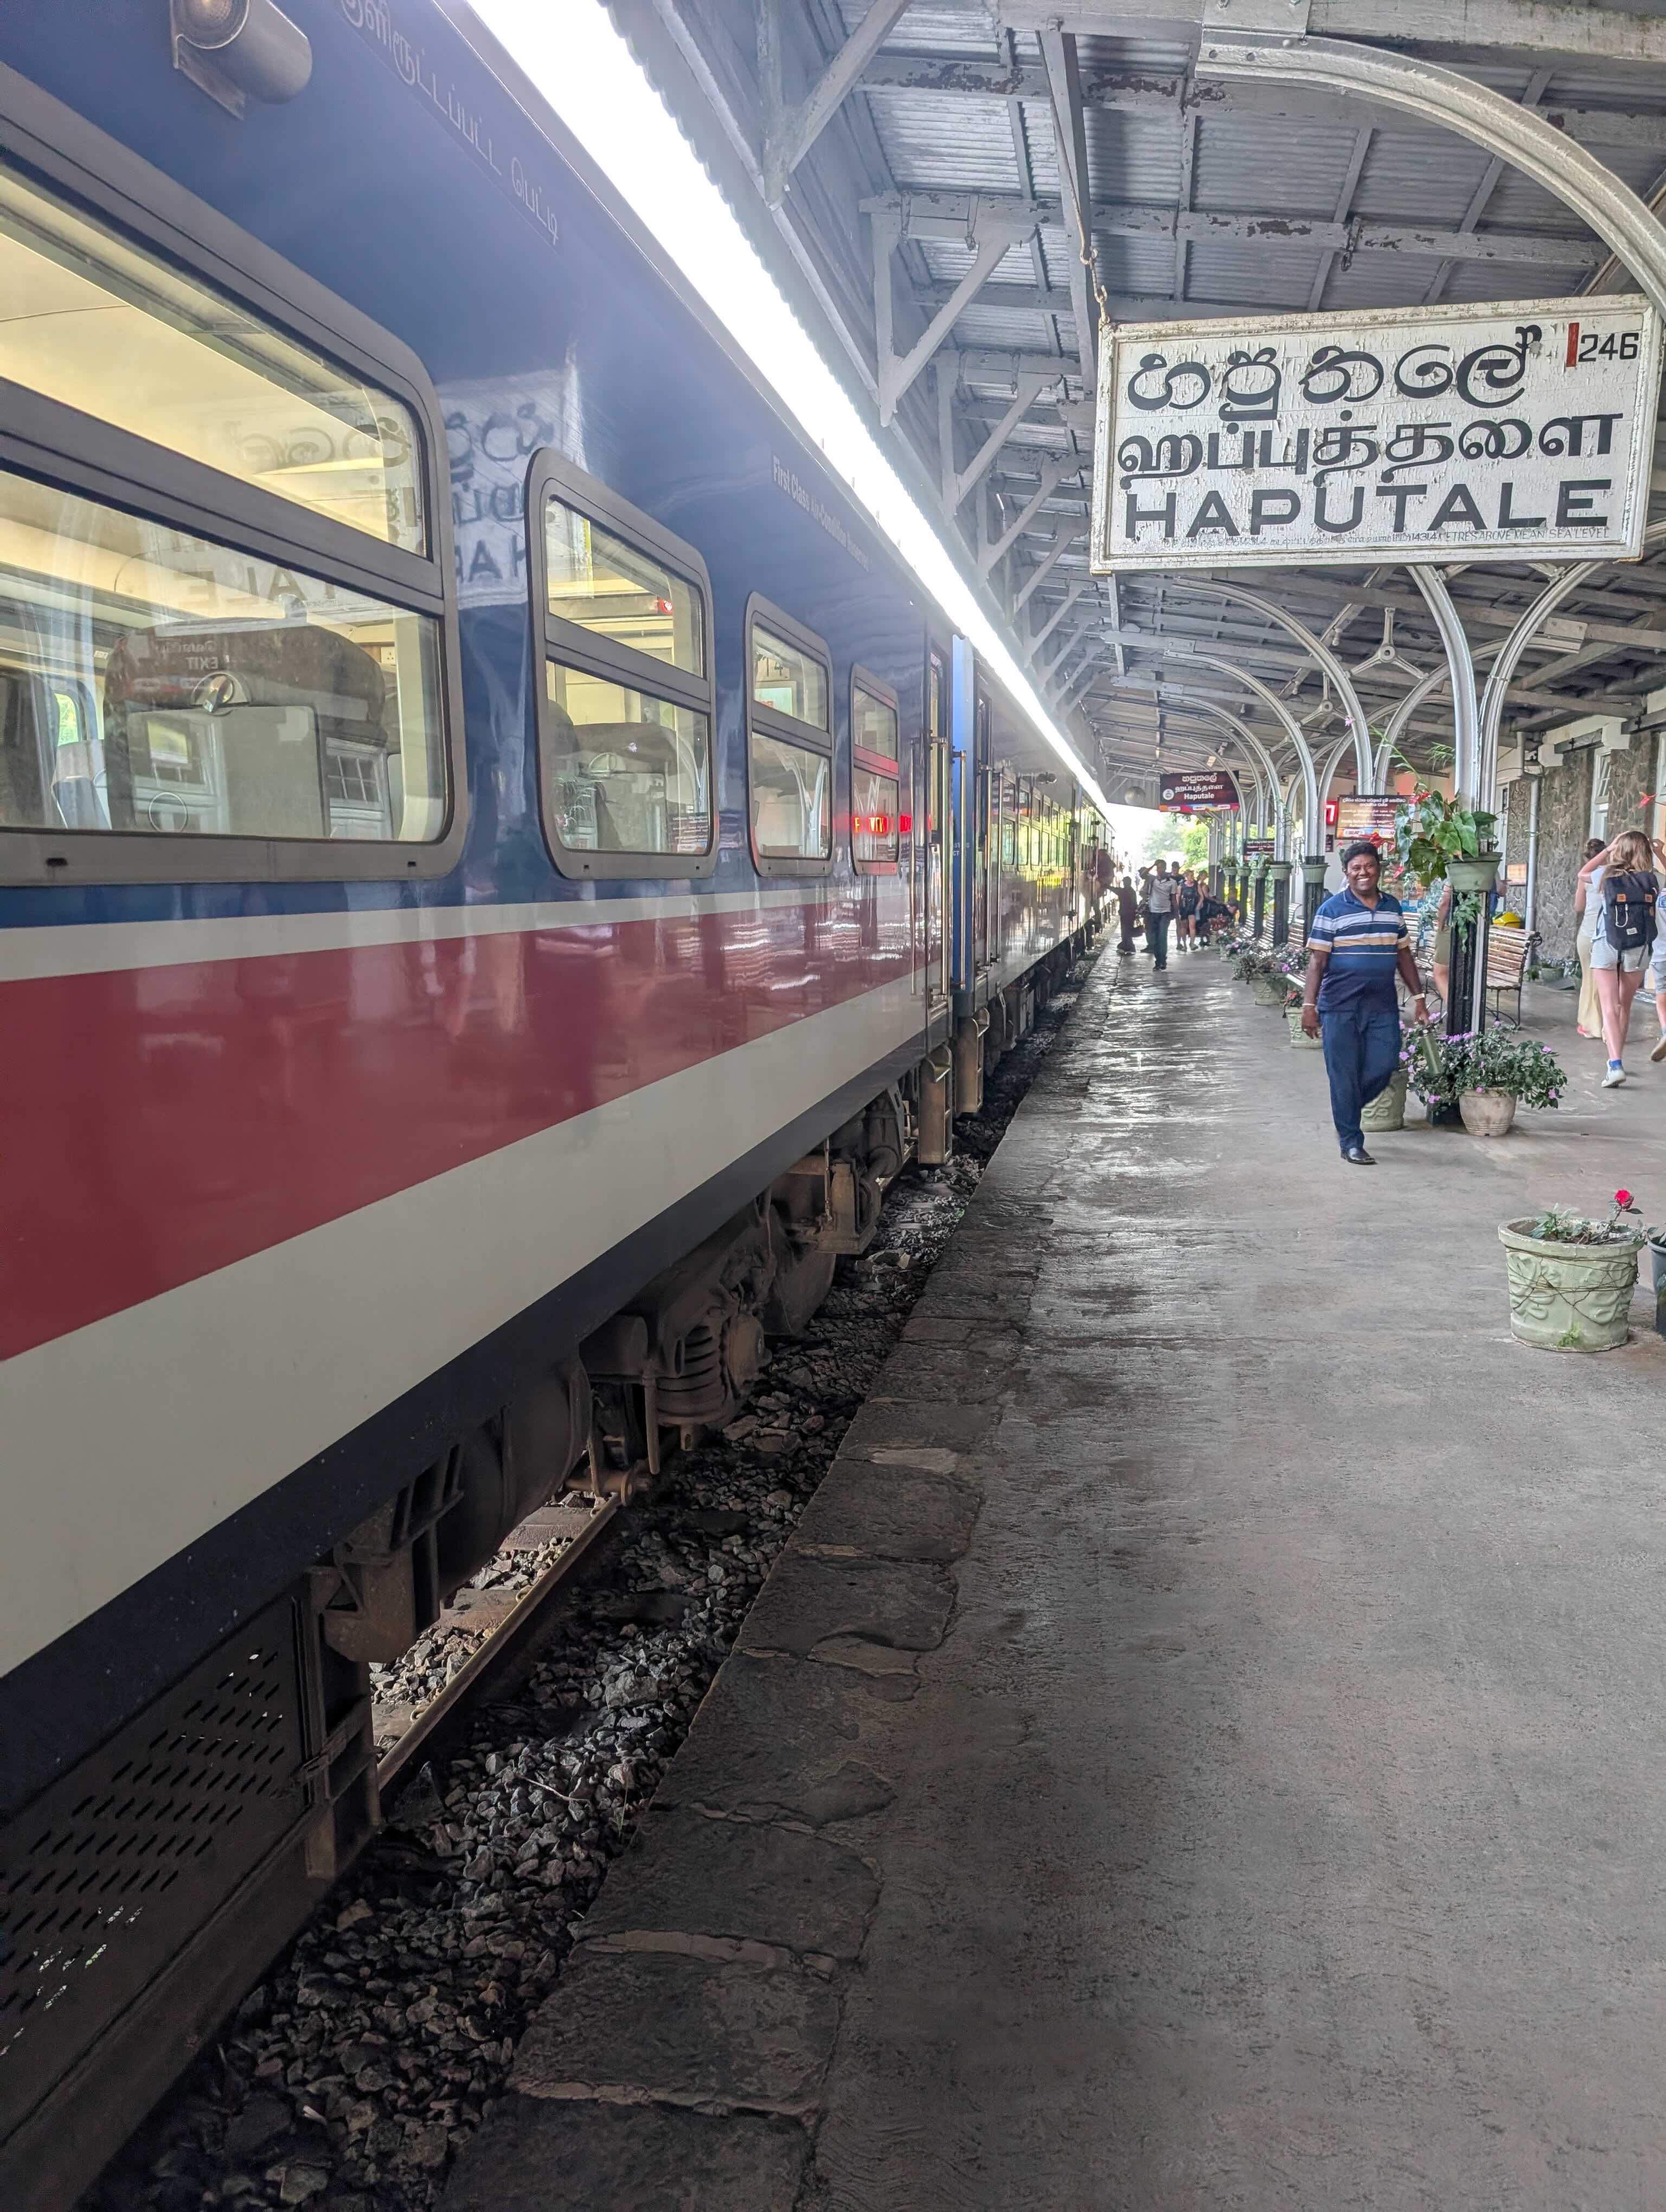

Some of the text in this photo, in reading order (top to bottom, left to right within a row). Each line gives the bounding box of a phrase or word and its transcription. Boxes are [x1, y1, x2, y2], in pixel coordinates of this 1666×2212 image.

[1578, 332, 1639, 363] 246
[773, 455, 790, 495] First
[791, 473, 810, 512] Class
[1125, 479, 1612, 538] HAPUTALE
[1478, 529, 1511, 541] ABOVE
[1548, 528, 1572, 539] SEA
[1574, 526, 1610, 539] LEVEL
[1184, 792, 1215, 801] Haputale
